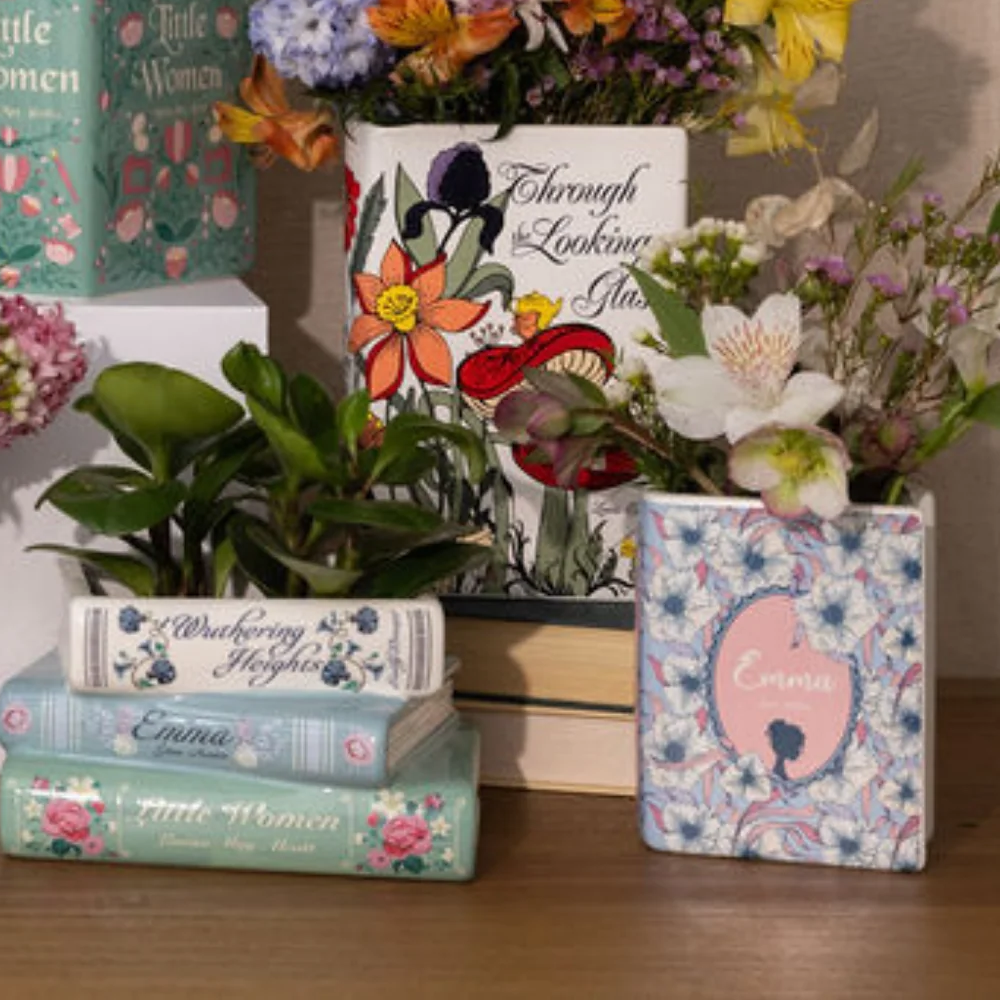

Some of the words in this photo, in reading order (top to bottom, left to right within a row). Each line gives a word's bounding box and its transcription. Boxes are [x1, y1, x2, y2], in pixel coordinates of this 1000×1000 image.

[148, 1, 208, 55] Little
[131, 57, 223, 99] Women
[498, 162, 651, 217] Through
[163, 606, 306, 655] Wuthering
[212, 642, 324, 687] Heights
[732, 649, 835, 693] Emma
[131, 708, 234, 747] Emma
[136, 796, 211, 828] Little
[221, 801, 340, 832] Women
